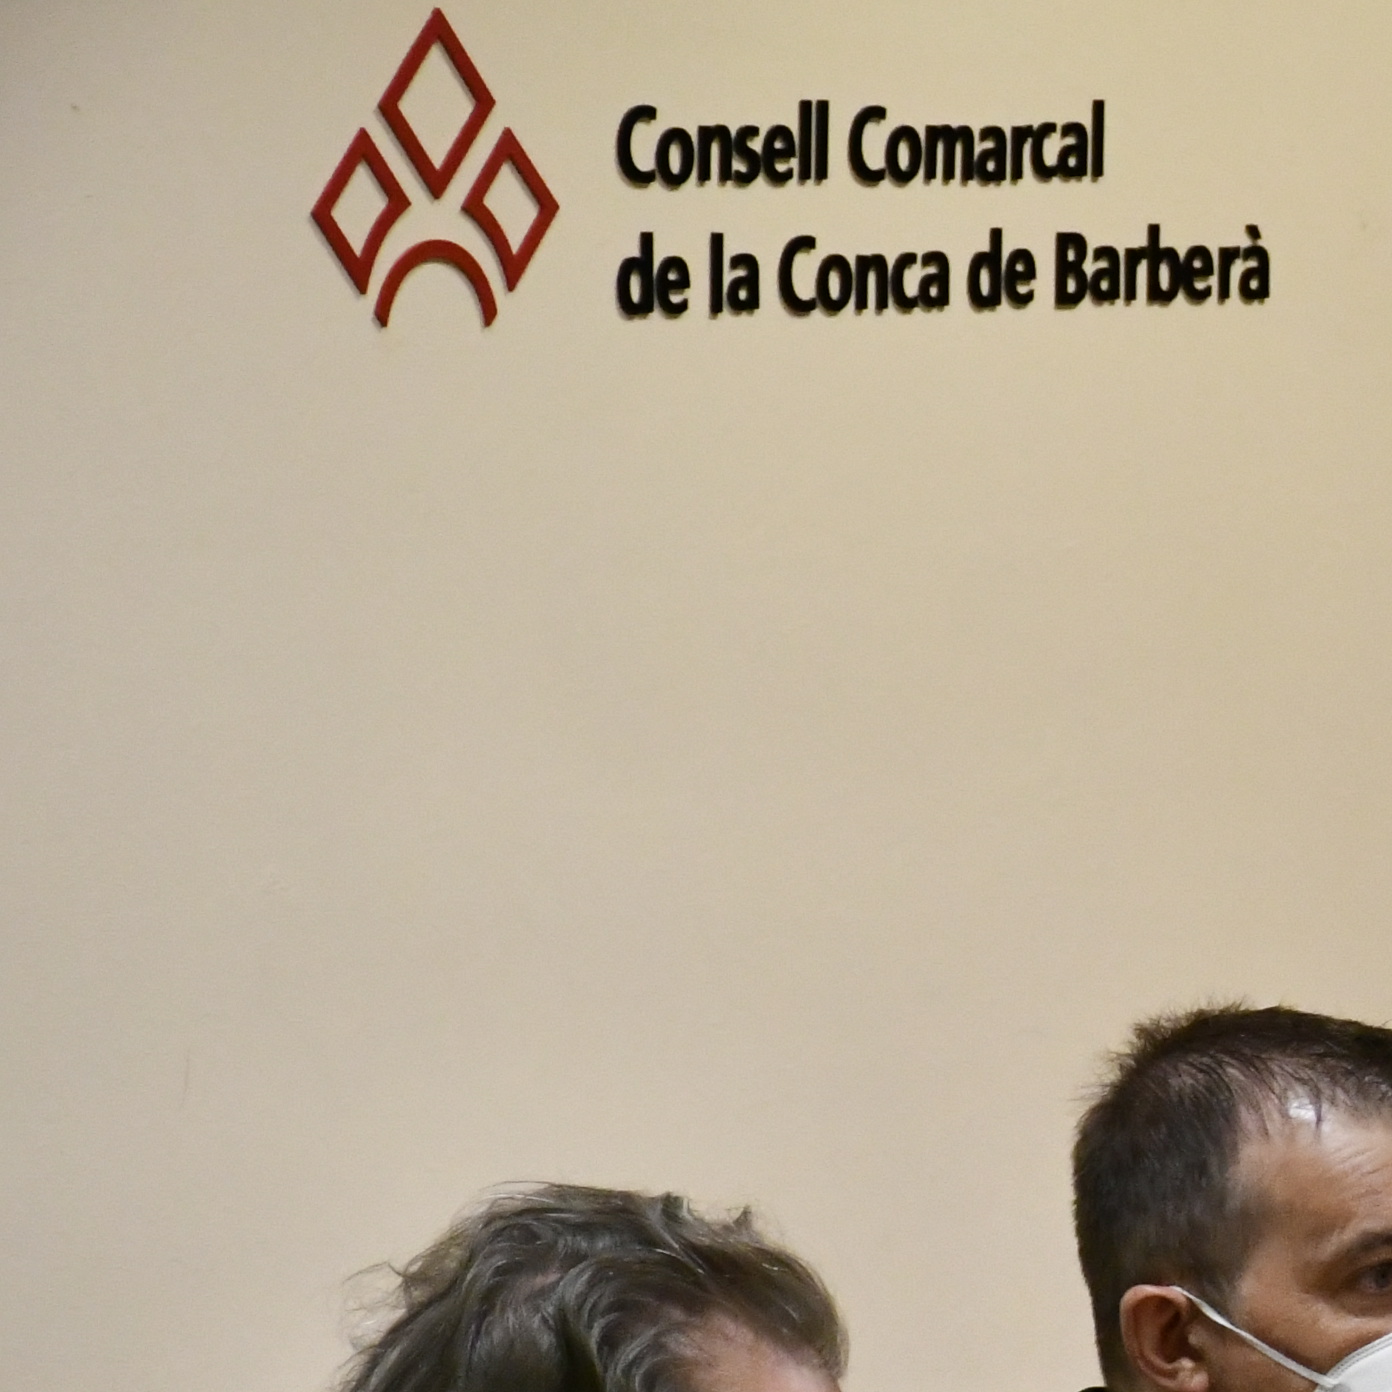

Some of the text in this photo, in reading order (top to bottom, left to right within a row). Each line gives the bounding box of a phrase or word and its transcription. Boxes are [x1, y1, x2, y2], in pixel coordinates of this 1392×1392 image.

[615, 99, 1106, 188] Consell Comarcal
[615, 224, 1271, 317] de la Conca de Barberà
